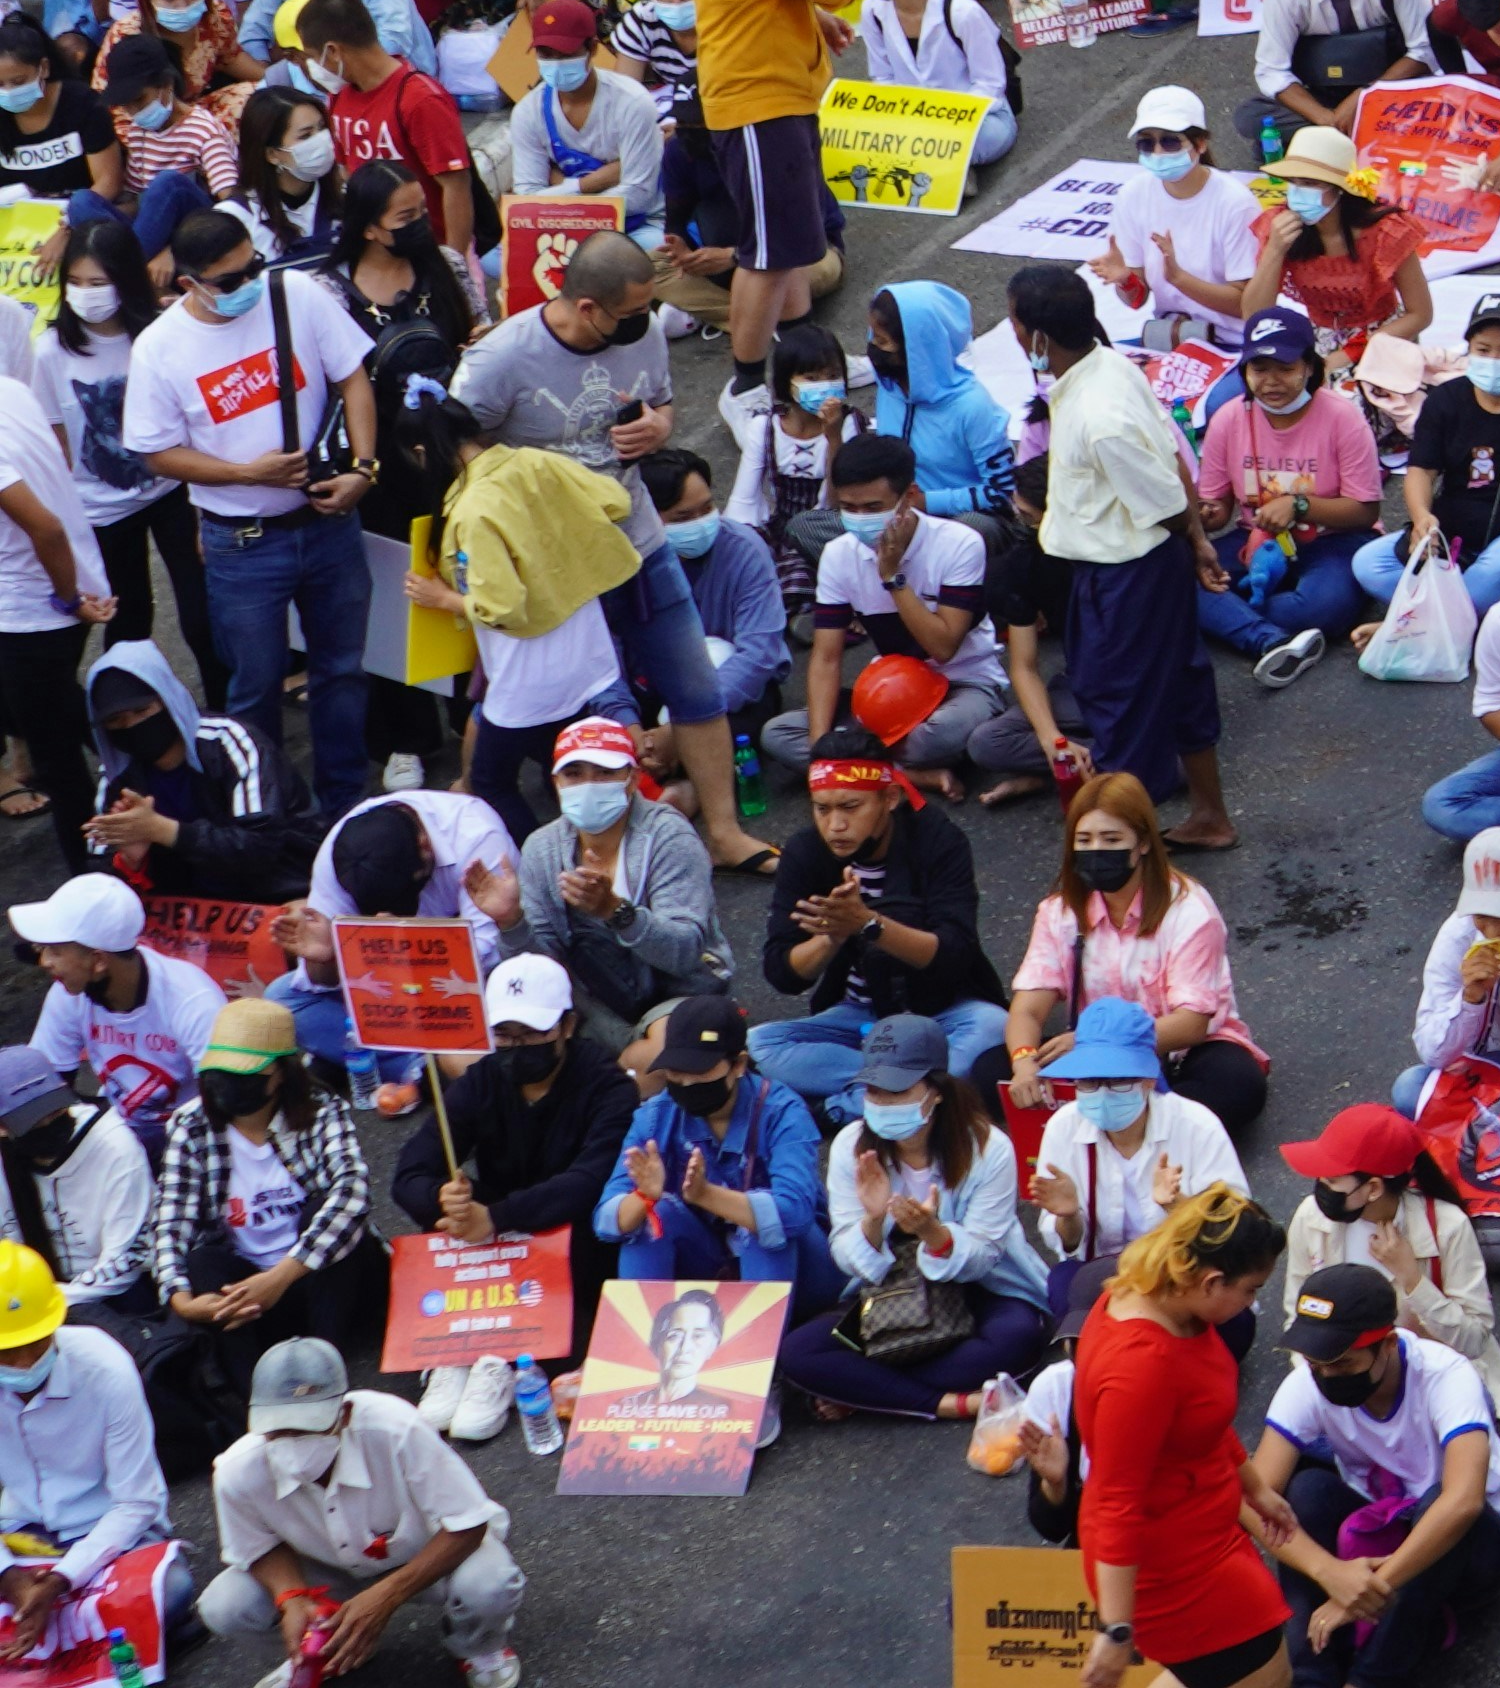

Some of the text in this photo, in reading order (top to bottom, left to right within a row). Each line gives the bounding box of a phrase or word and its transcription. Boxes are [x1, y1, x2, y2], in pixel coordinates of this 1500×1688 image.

[1021, 15, 1066, 33] RELEAS
[831, 89, 977, 125] We Don't Accept
[1381, 100, 1458, 126] HELP
[332, 115, 404, 160] USA
[821, 126, 962, 161] MILITARY COUP
[1243, 455, 1319, 473] BELIEVE
[146, 898, 264, 935] HELP US
[359, 938, 448, 955] HELP US
[363, 1004, 472, 1021] STOP CRIME
[444, 1284, 519, 1312] UN & U.S.
[606, 1403, 729, 1418] PLEASE SAVE OUR
[577, 1419, 753, 1434] LEADER FUTURE HOPE
